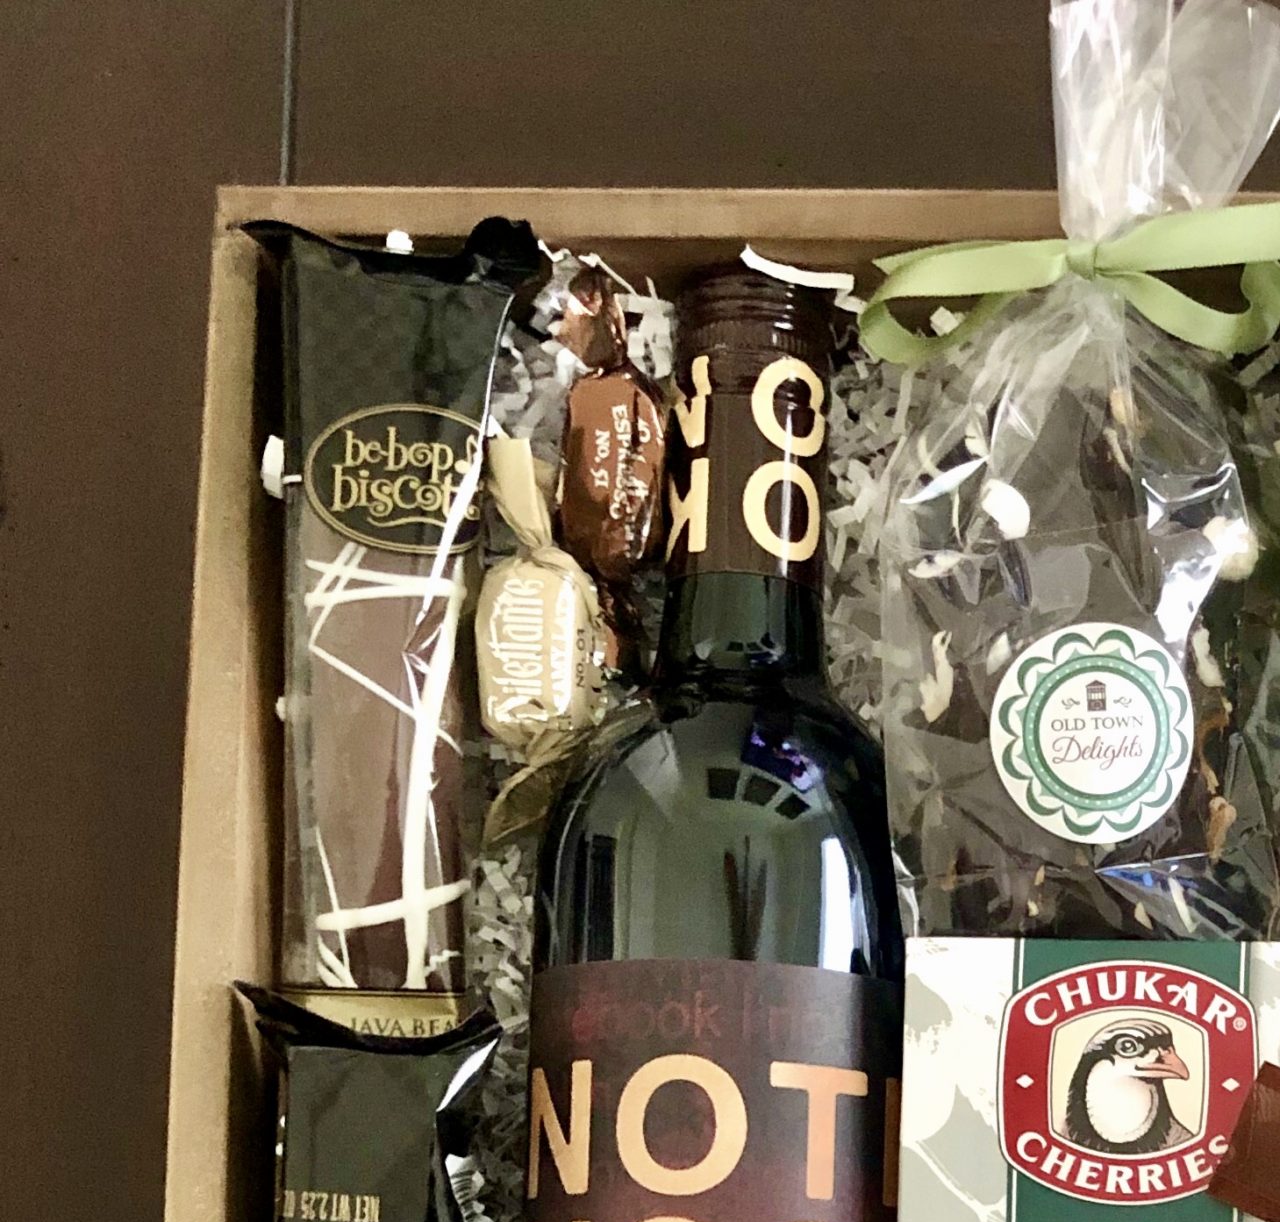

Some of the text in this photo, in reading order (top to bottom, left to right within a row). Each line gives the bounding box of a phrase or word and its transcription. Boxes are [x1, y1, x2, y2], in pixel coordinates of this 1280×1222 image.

[331, 464, 481, 521] biscot
[1051, 715, 1143, 732] OLD TOWN
[1052, 735, 1143, 770] Delights
[350, 1017, 406, 1038] JAVA
[527, 1053, 899, 1206] NOT
[1016, 1131, 1229, 1194] CHERRIES
